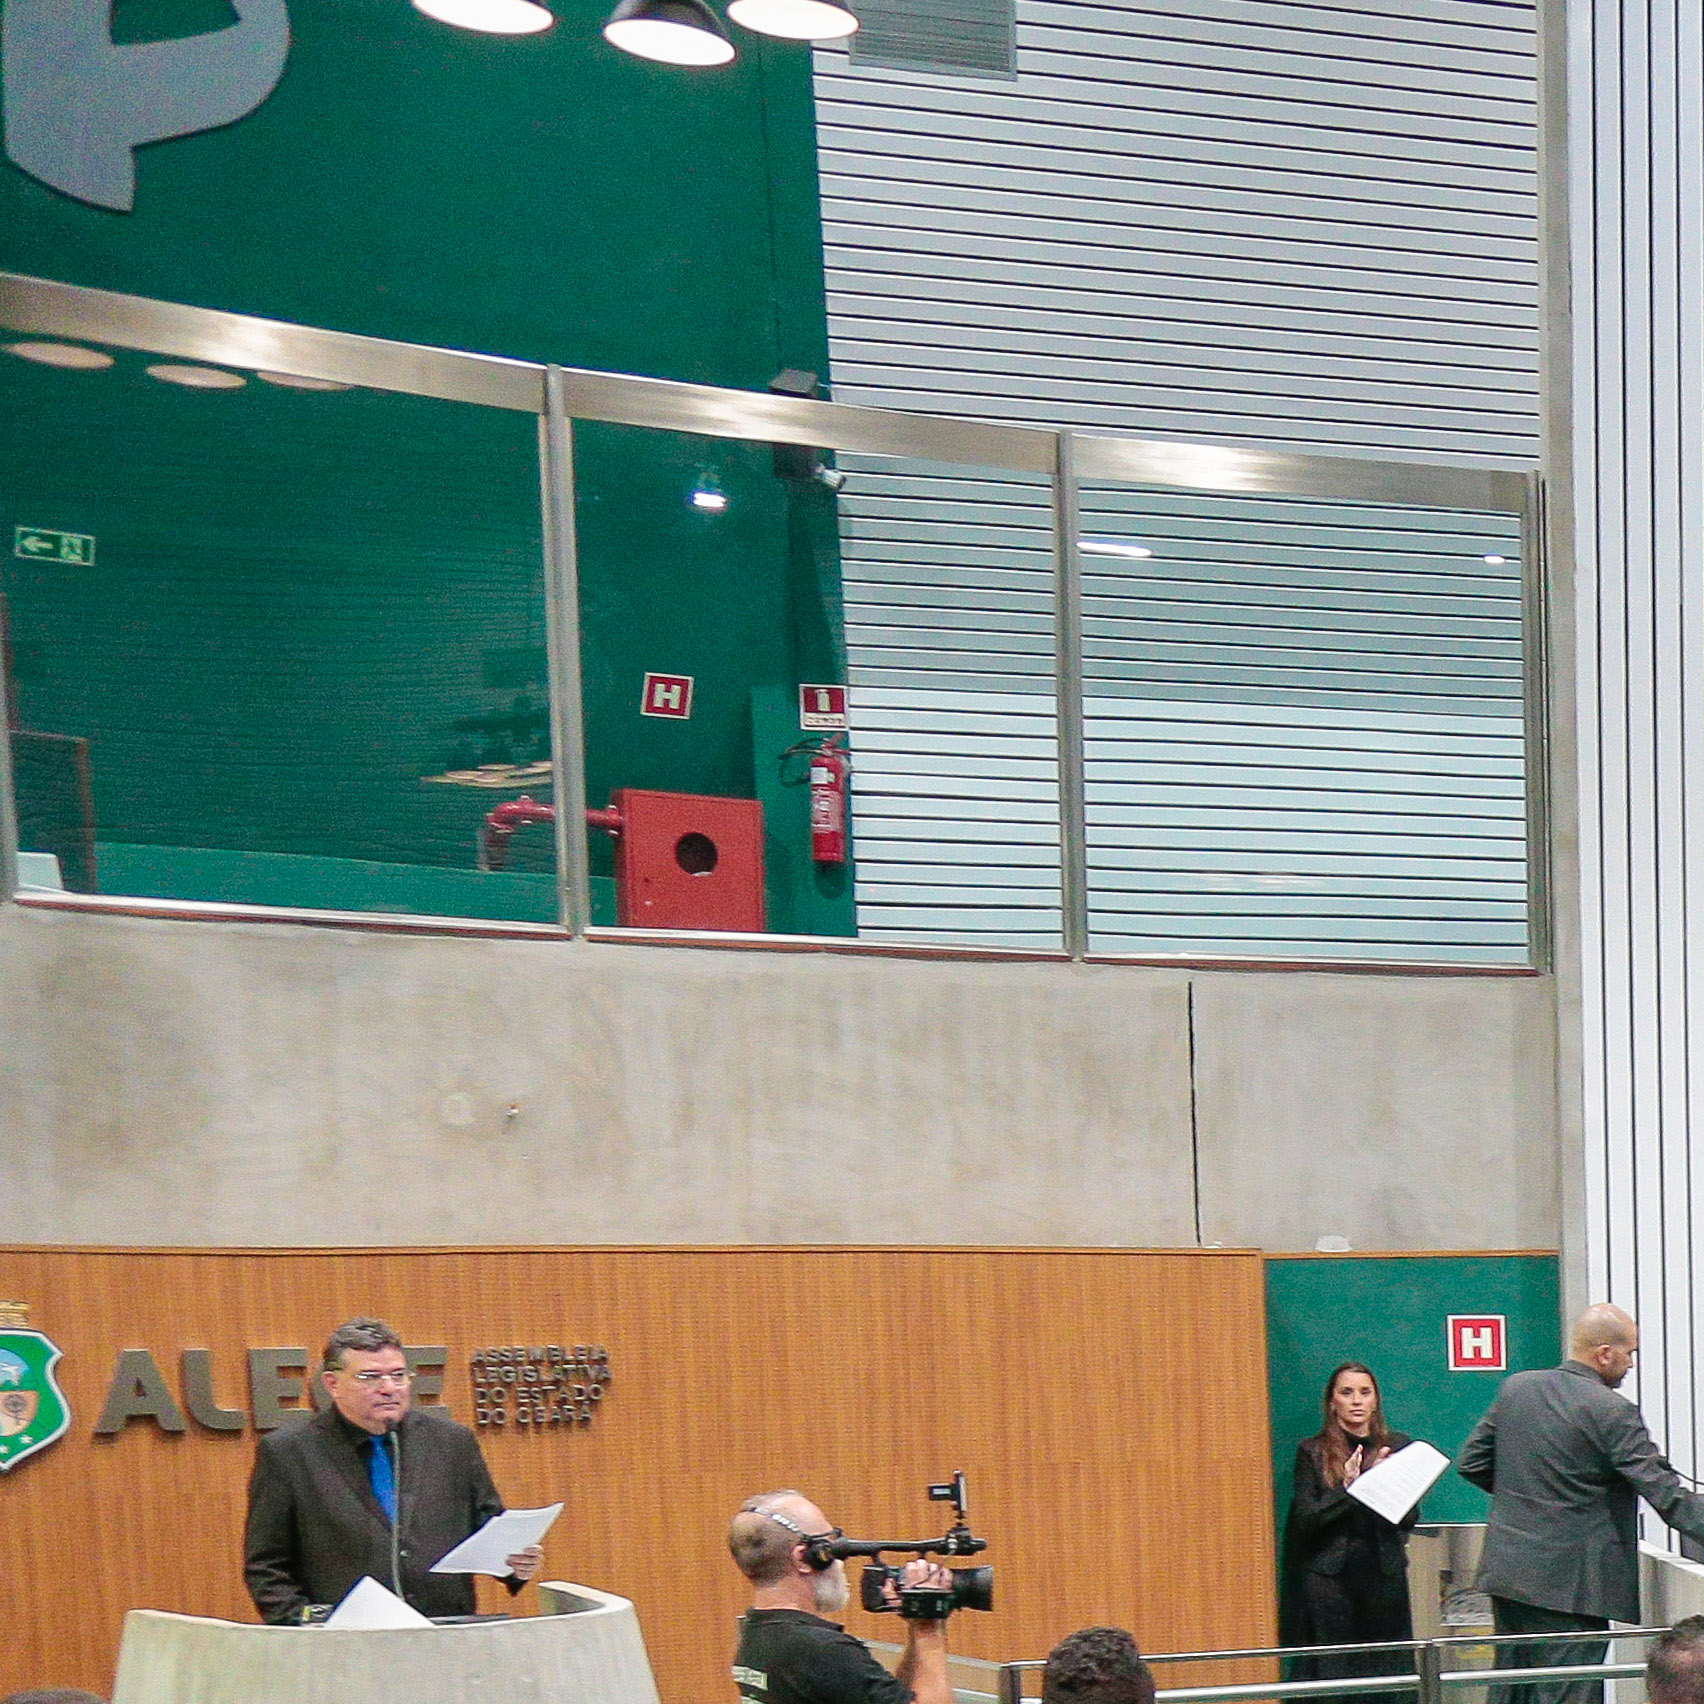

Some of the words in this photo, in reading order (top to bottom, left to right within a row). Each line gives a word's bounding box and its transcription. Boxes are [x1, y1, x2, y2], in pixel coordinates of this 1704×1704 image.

[652, 683, 682, 710] H
[1461, 1327, 1493, 1359] H
[93, 1346, 448, 1432] ALEE
[475, 1386, 507, 1404] DO
[516, 1384, 604, 1403] ESTADO
[476, 1406, 508, 1425] DO
